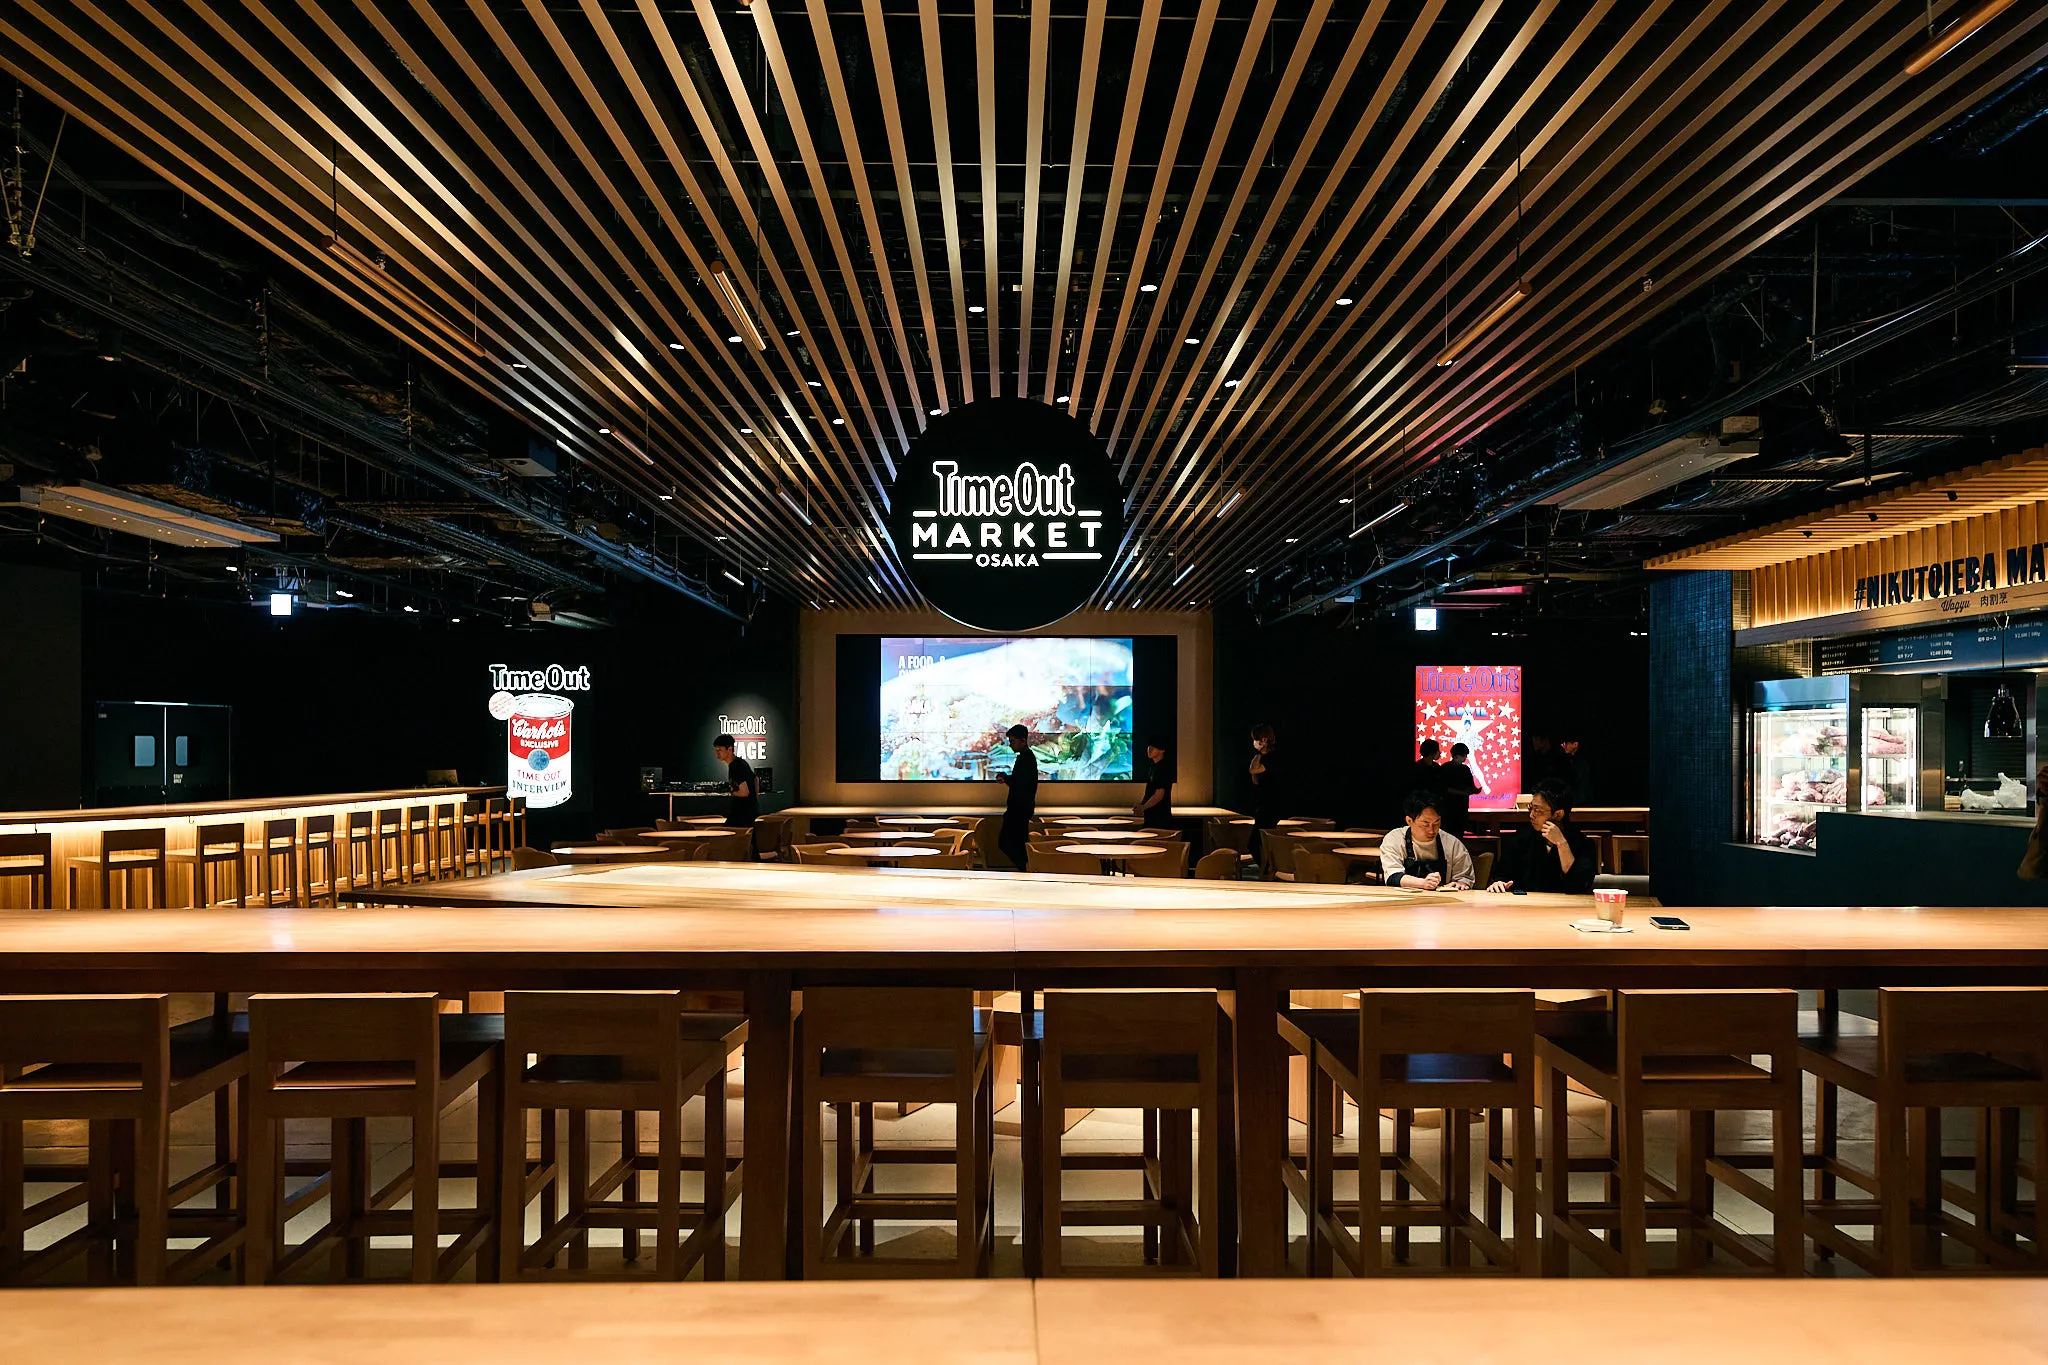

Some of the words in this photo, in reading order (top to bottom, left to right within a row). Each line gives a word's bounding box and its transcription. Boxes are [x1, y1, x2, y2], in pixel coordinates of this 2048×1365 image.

[912, 521, 1103, 548] MARKET
[975, 552, 1040, 567] OSAKA
[2006, 541, 2048, 587] MA
[1940, 599, 1971, 613] Wagyu
[1980, 592, 2008, 608] 肉割烹
[898, 655, 906, 669] A
[908, 655, 934, 669] FOOD
[520, 739, 559, 749] EXCLUSIVE
[517, 770, 540, 781] TIME
[543, 770, 561, 782] OUT
[512, 779, 567, 794] INTERVIEW
